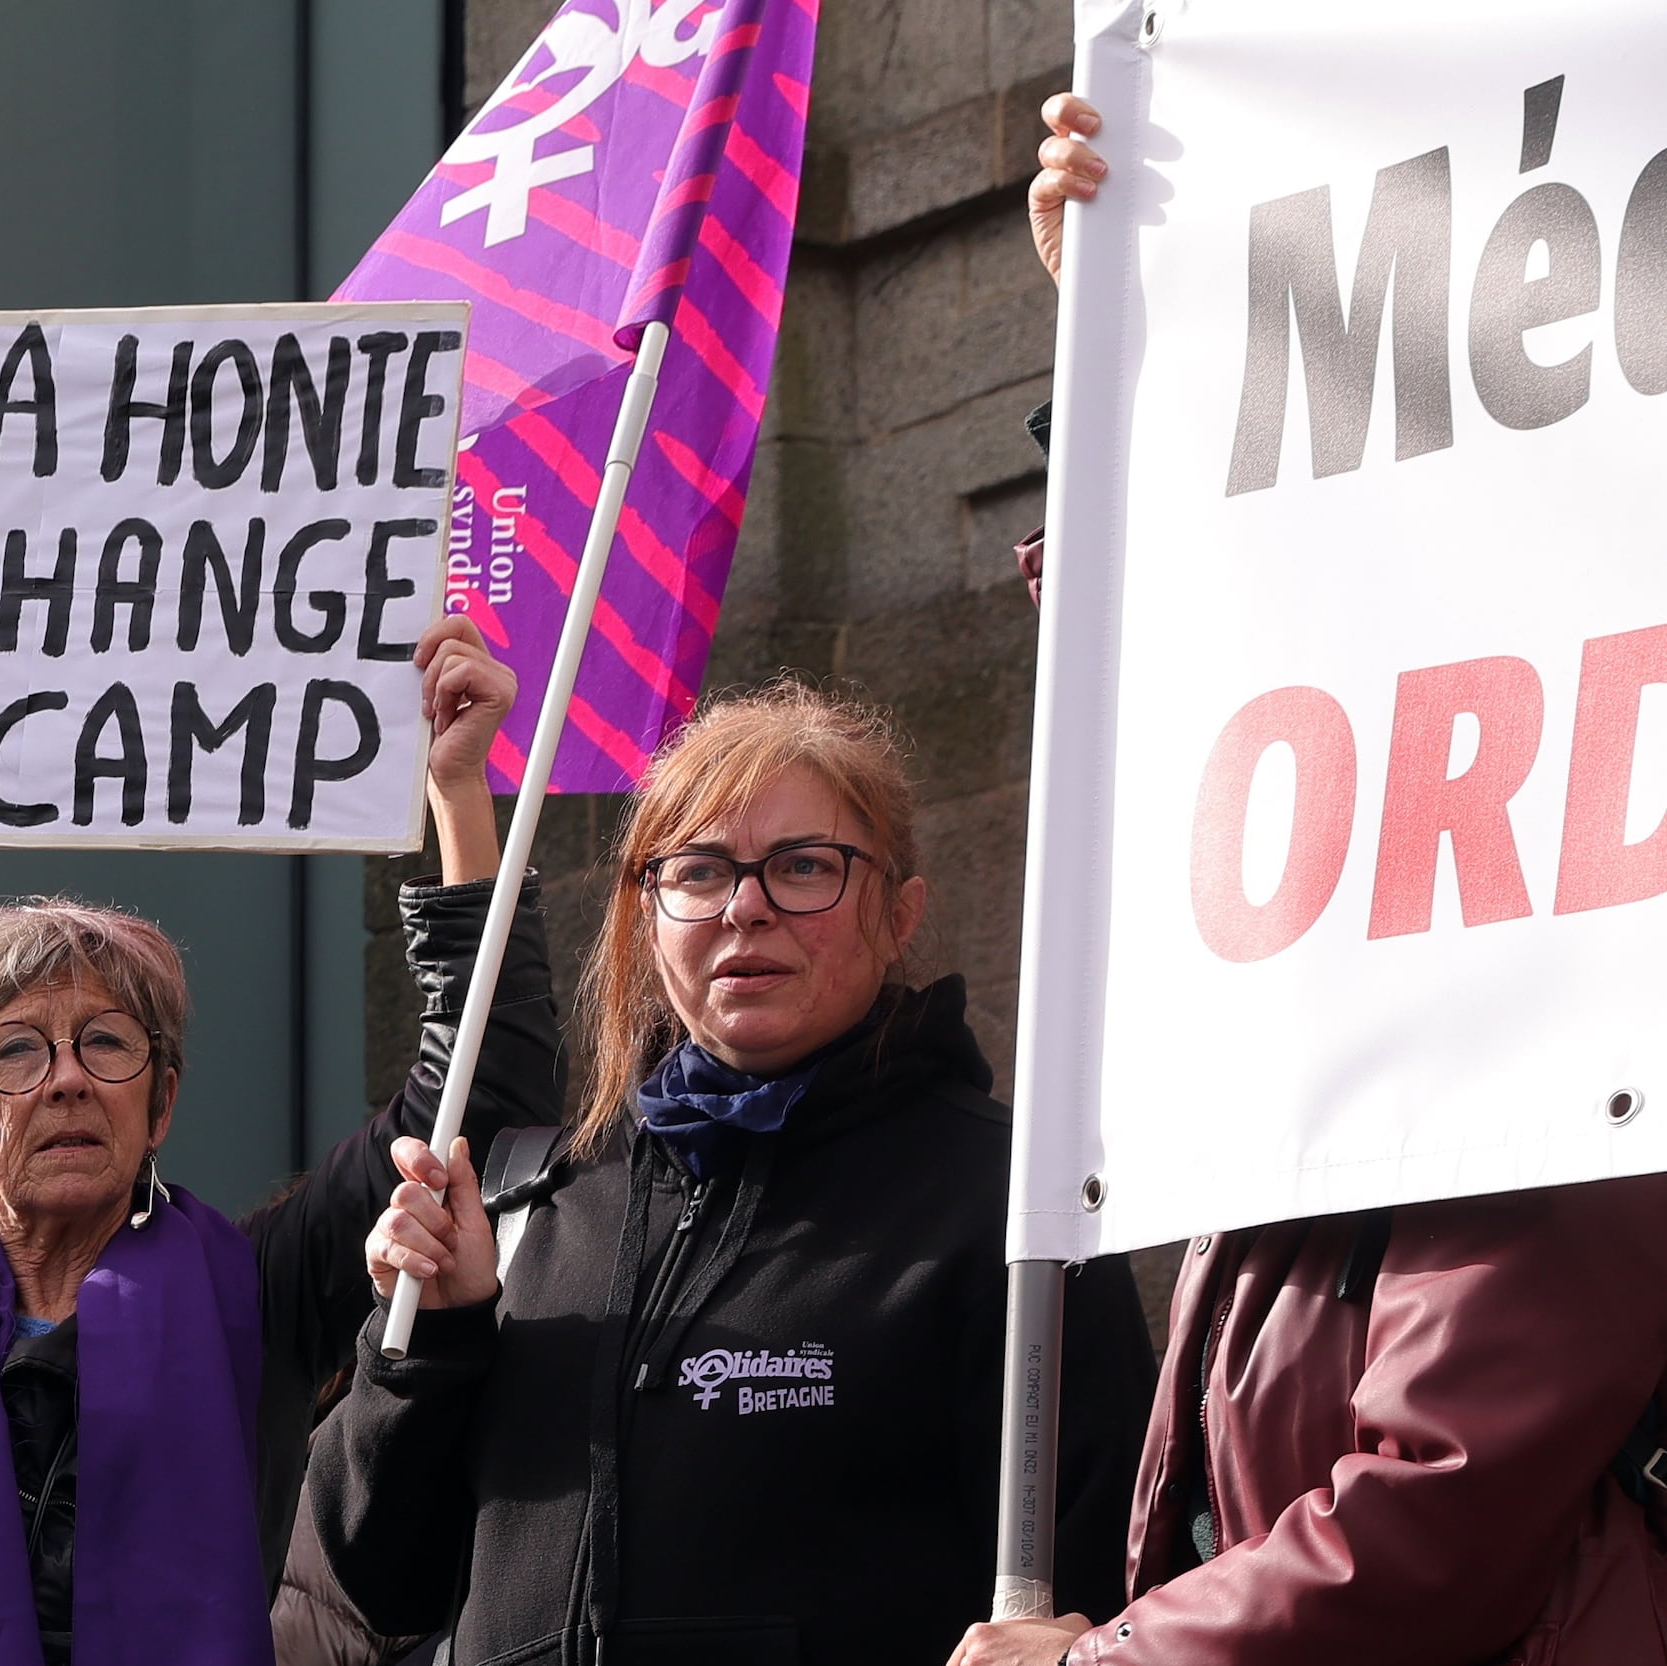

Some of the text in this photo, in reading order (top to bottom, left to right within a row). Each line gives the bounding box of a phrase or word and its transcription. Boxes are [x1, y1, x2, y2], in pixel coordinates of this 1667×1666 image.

[100, 330, 462, 493] HONTE
[445, 485, 482, 617] syndic
[488, 484, 527, 605] Union
[1027, 1344, 1041, 1363] PVC
[738, 1385, 835, 1415] BRETAGNE
[1020, 1520, 1035, 1567] 03/10/24
